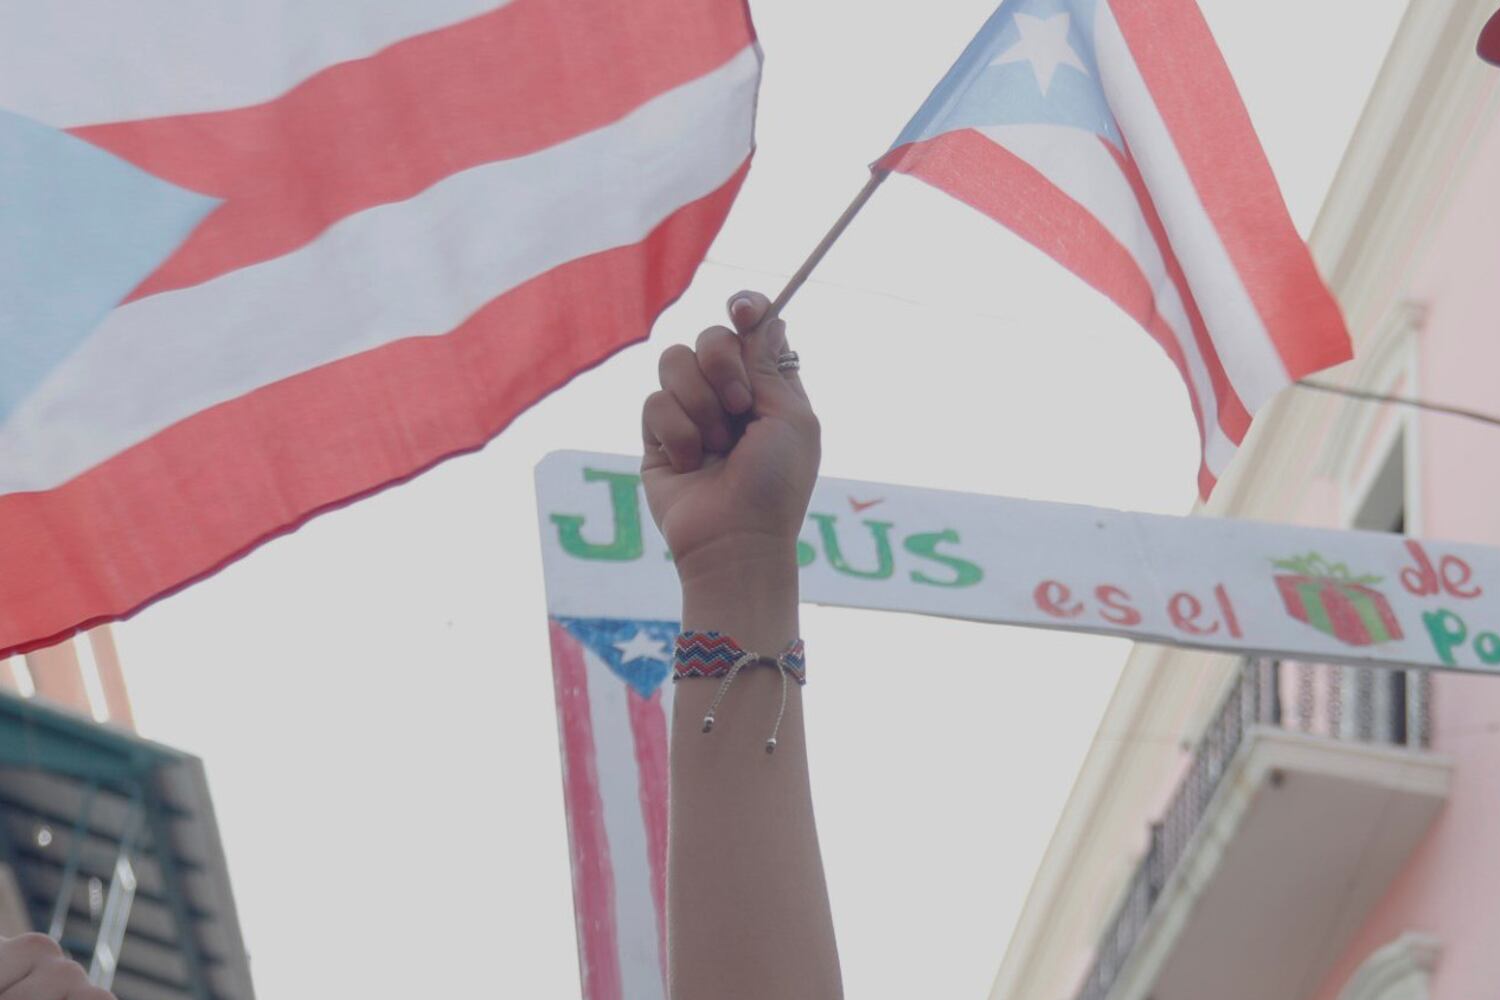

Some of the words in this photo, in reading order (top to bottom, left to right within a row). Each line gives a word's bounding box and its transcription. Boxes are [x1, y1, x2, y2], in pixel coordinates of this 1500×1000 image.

[549, 467, 985, 589] JÚS
[1033, 579, 1143, 627] es
[1166, 582, 1244, 640] el
[1400, 539, 1483, 600] de
